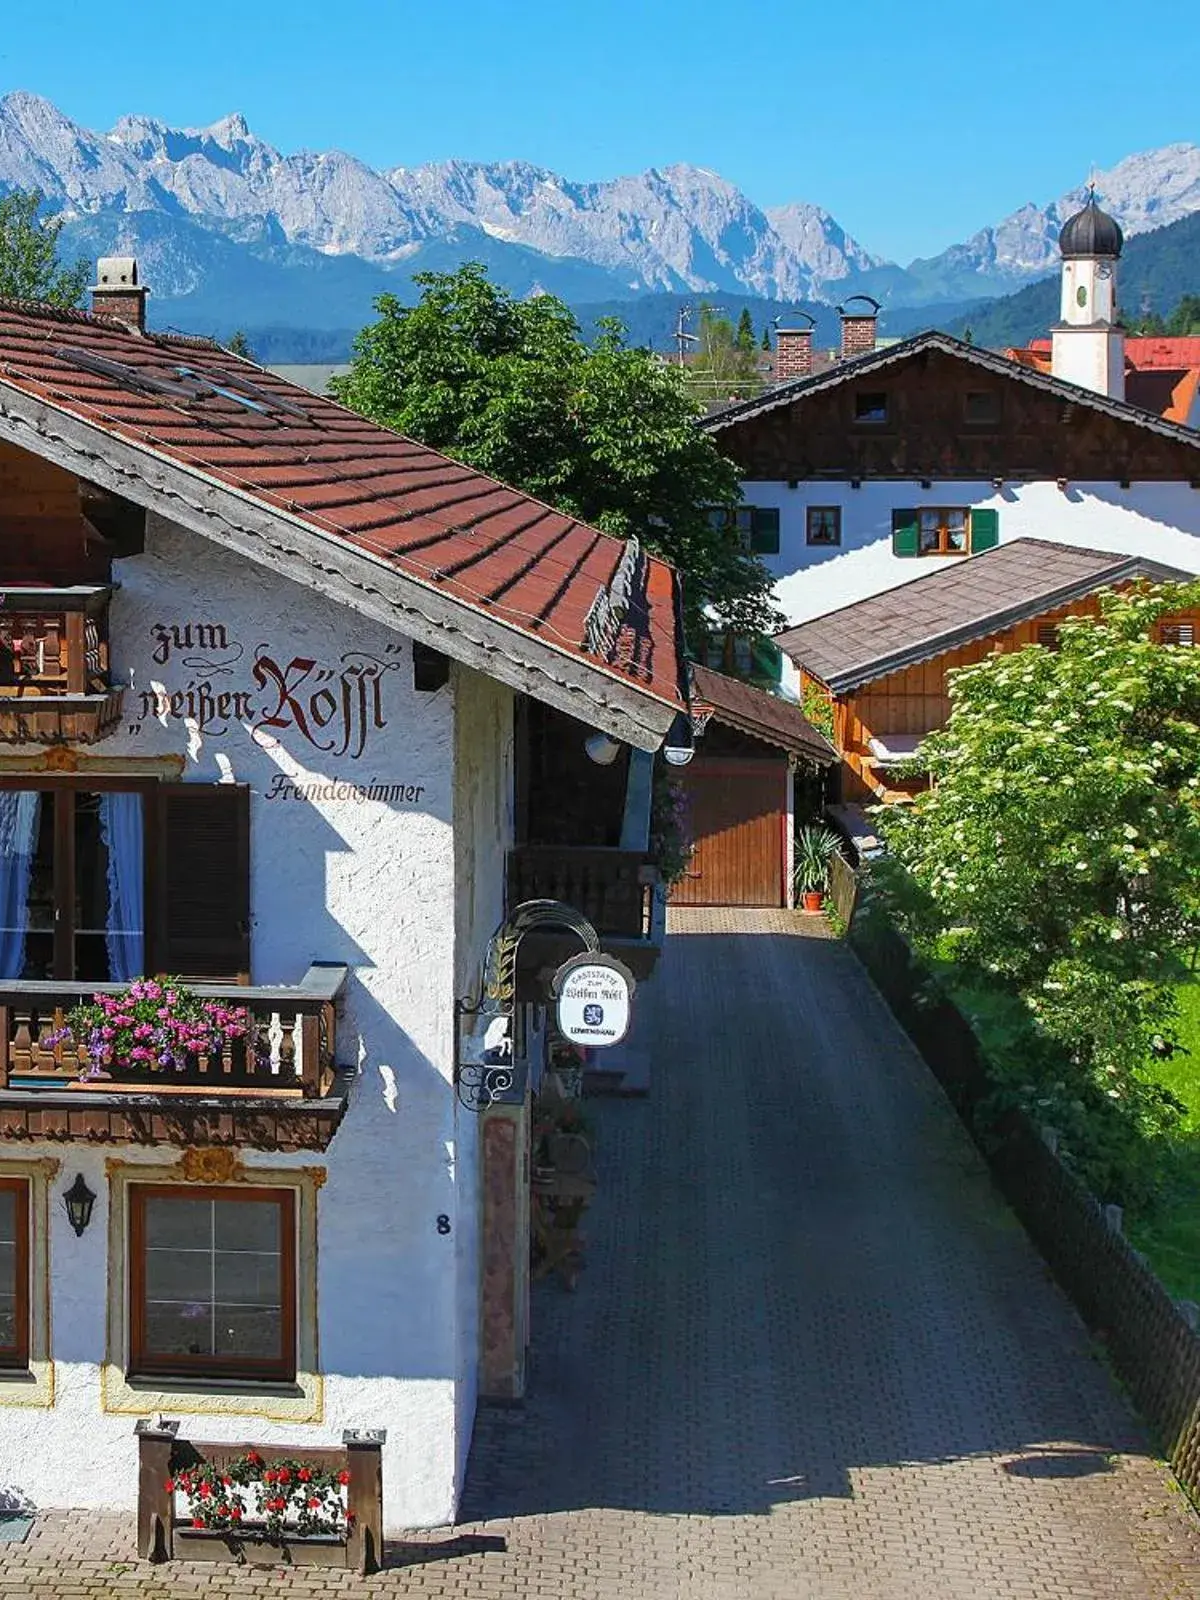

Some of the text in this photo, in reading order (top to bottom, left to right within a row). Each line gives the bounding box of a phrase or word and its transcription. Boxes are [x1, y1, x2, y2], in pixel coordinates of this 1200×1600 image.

[150, 622, 238, 668] zum
[265, 773, 425, 805] Fremdenzimmer
[436, 1214, 451, 1235] 8
